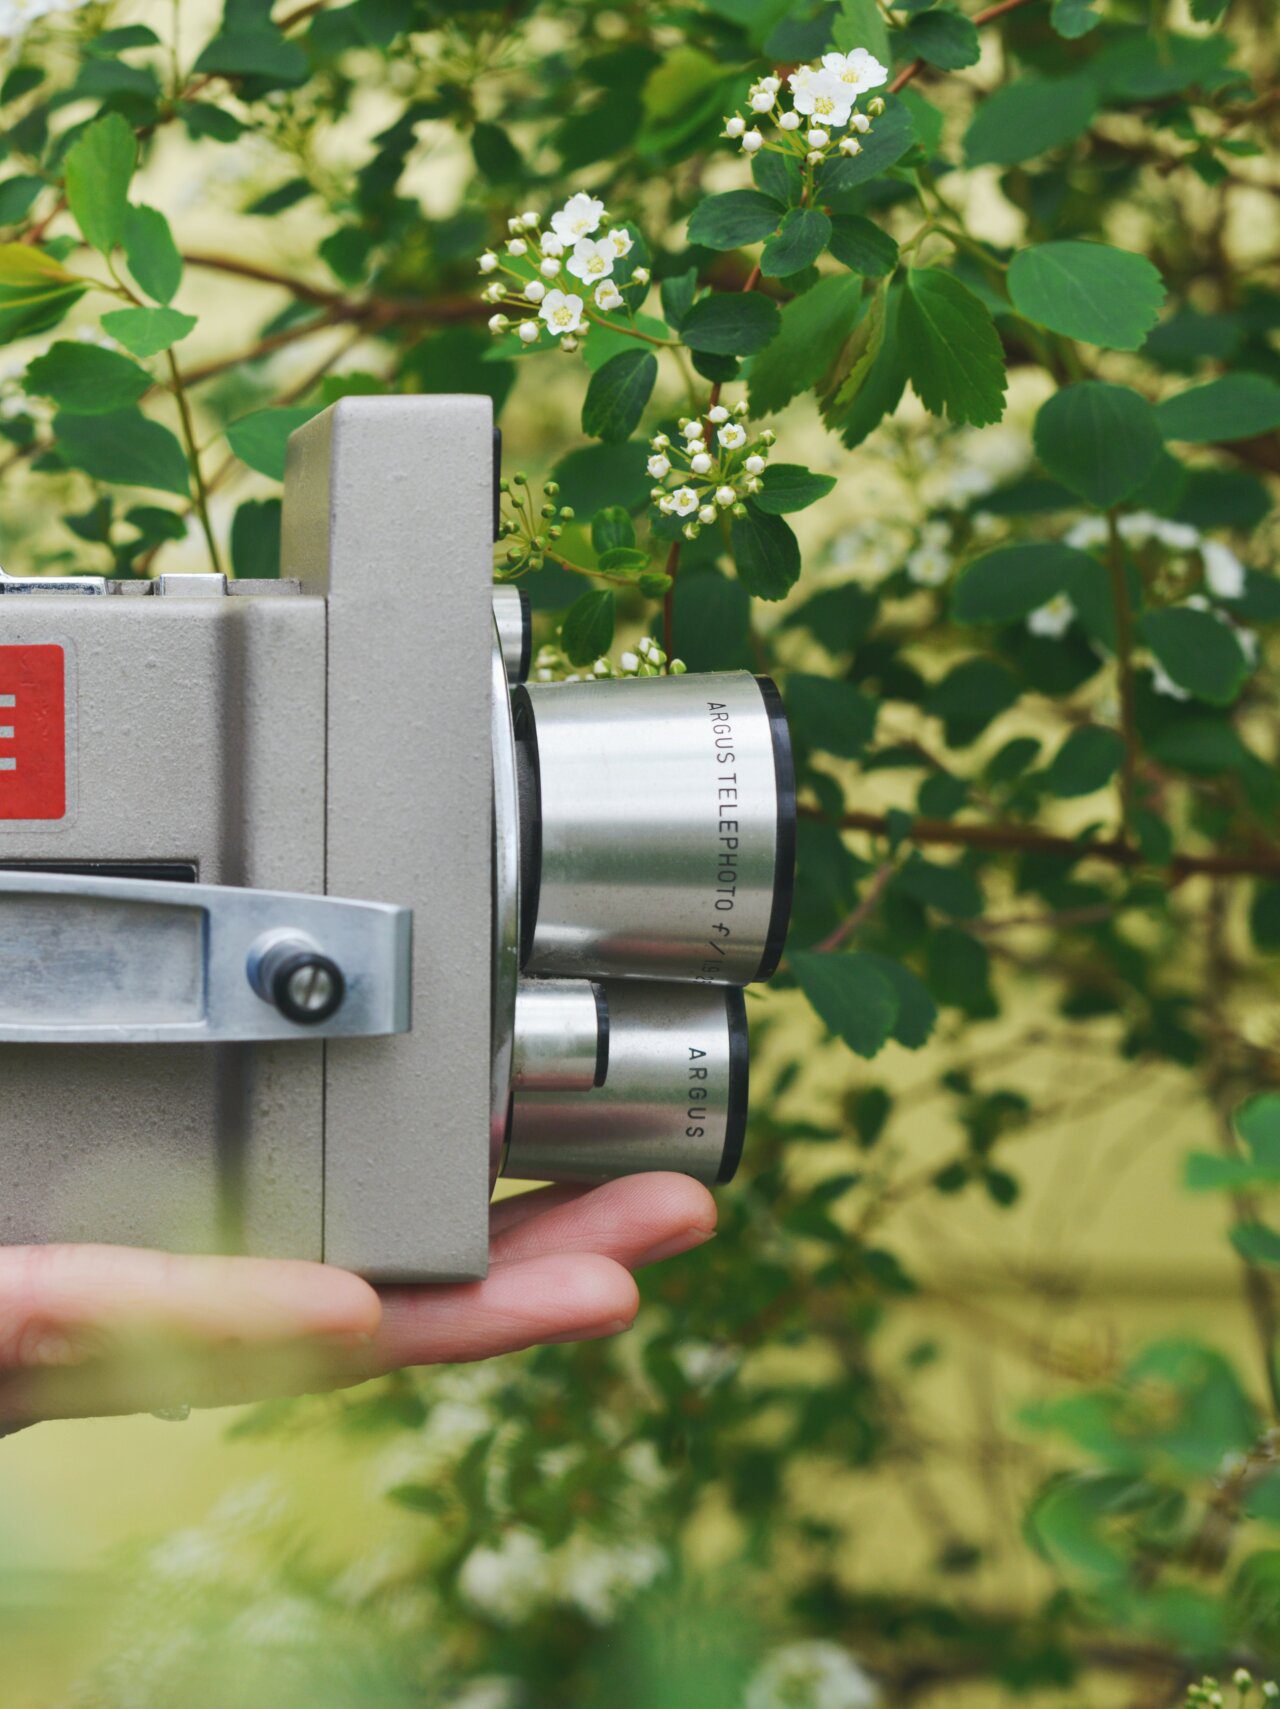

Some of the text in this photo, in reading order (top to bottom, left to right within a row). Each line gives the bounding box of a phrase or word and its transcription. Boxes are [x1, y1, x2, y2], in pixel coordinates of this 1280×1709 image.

[707, 701, 736, 765] ARGUS
[714, 772, 739, 912] TELEPHOTO
[685, 1047, 708, 1138] ARGUS
